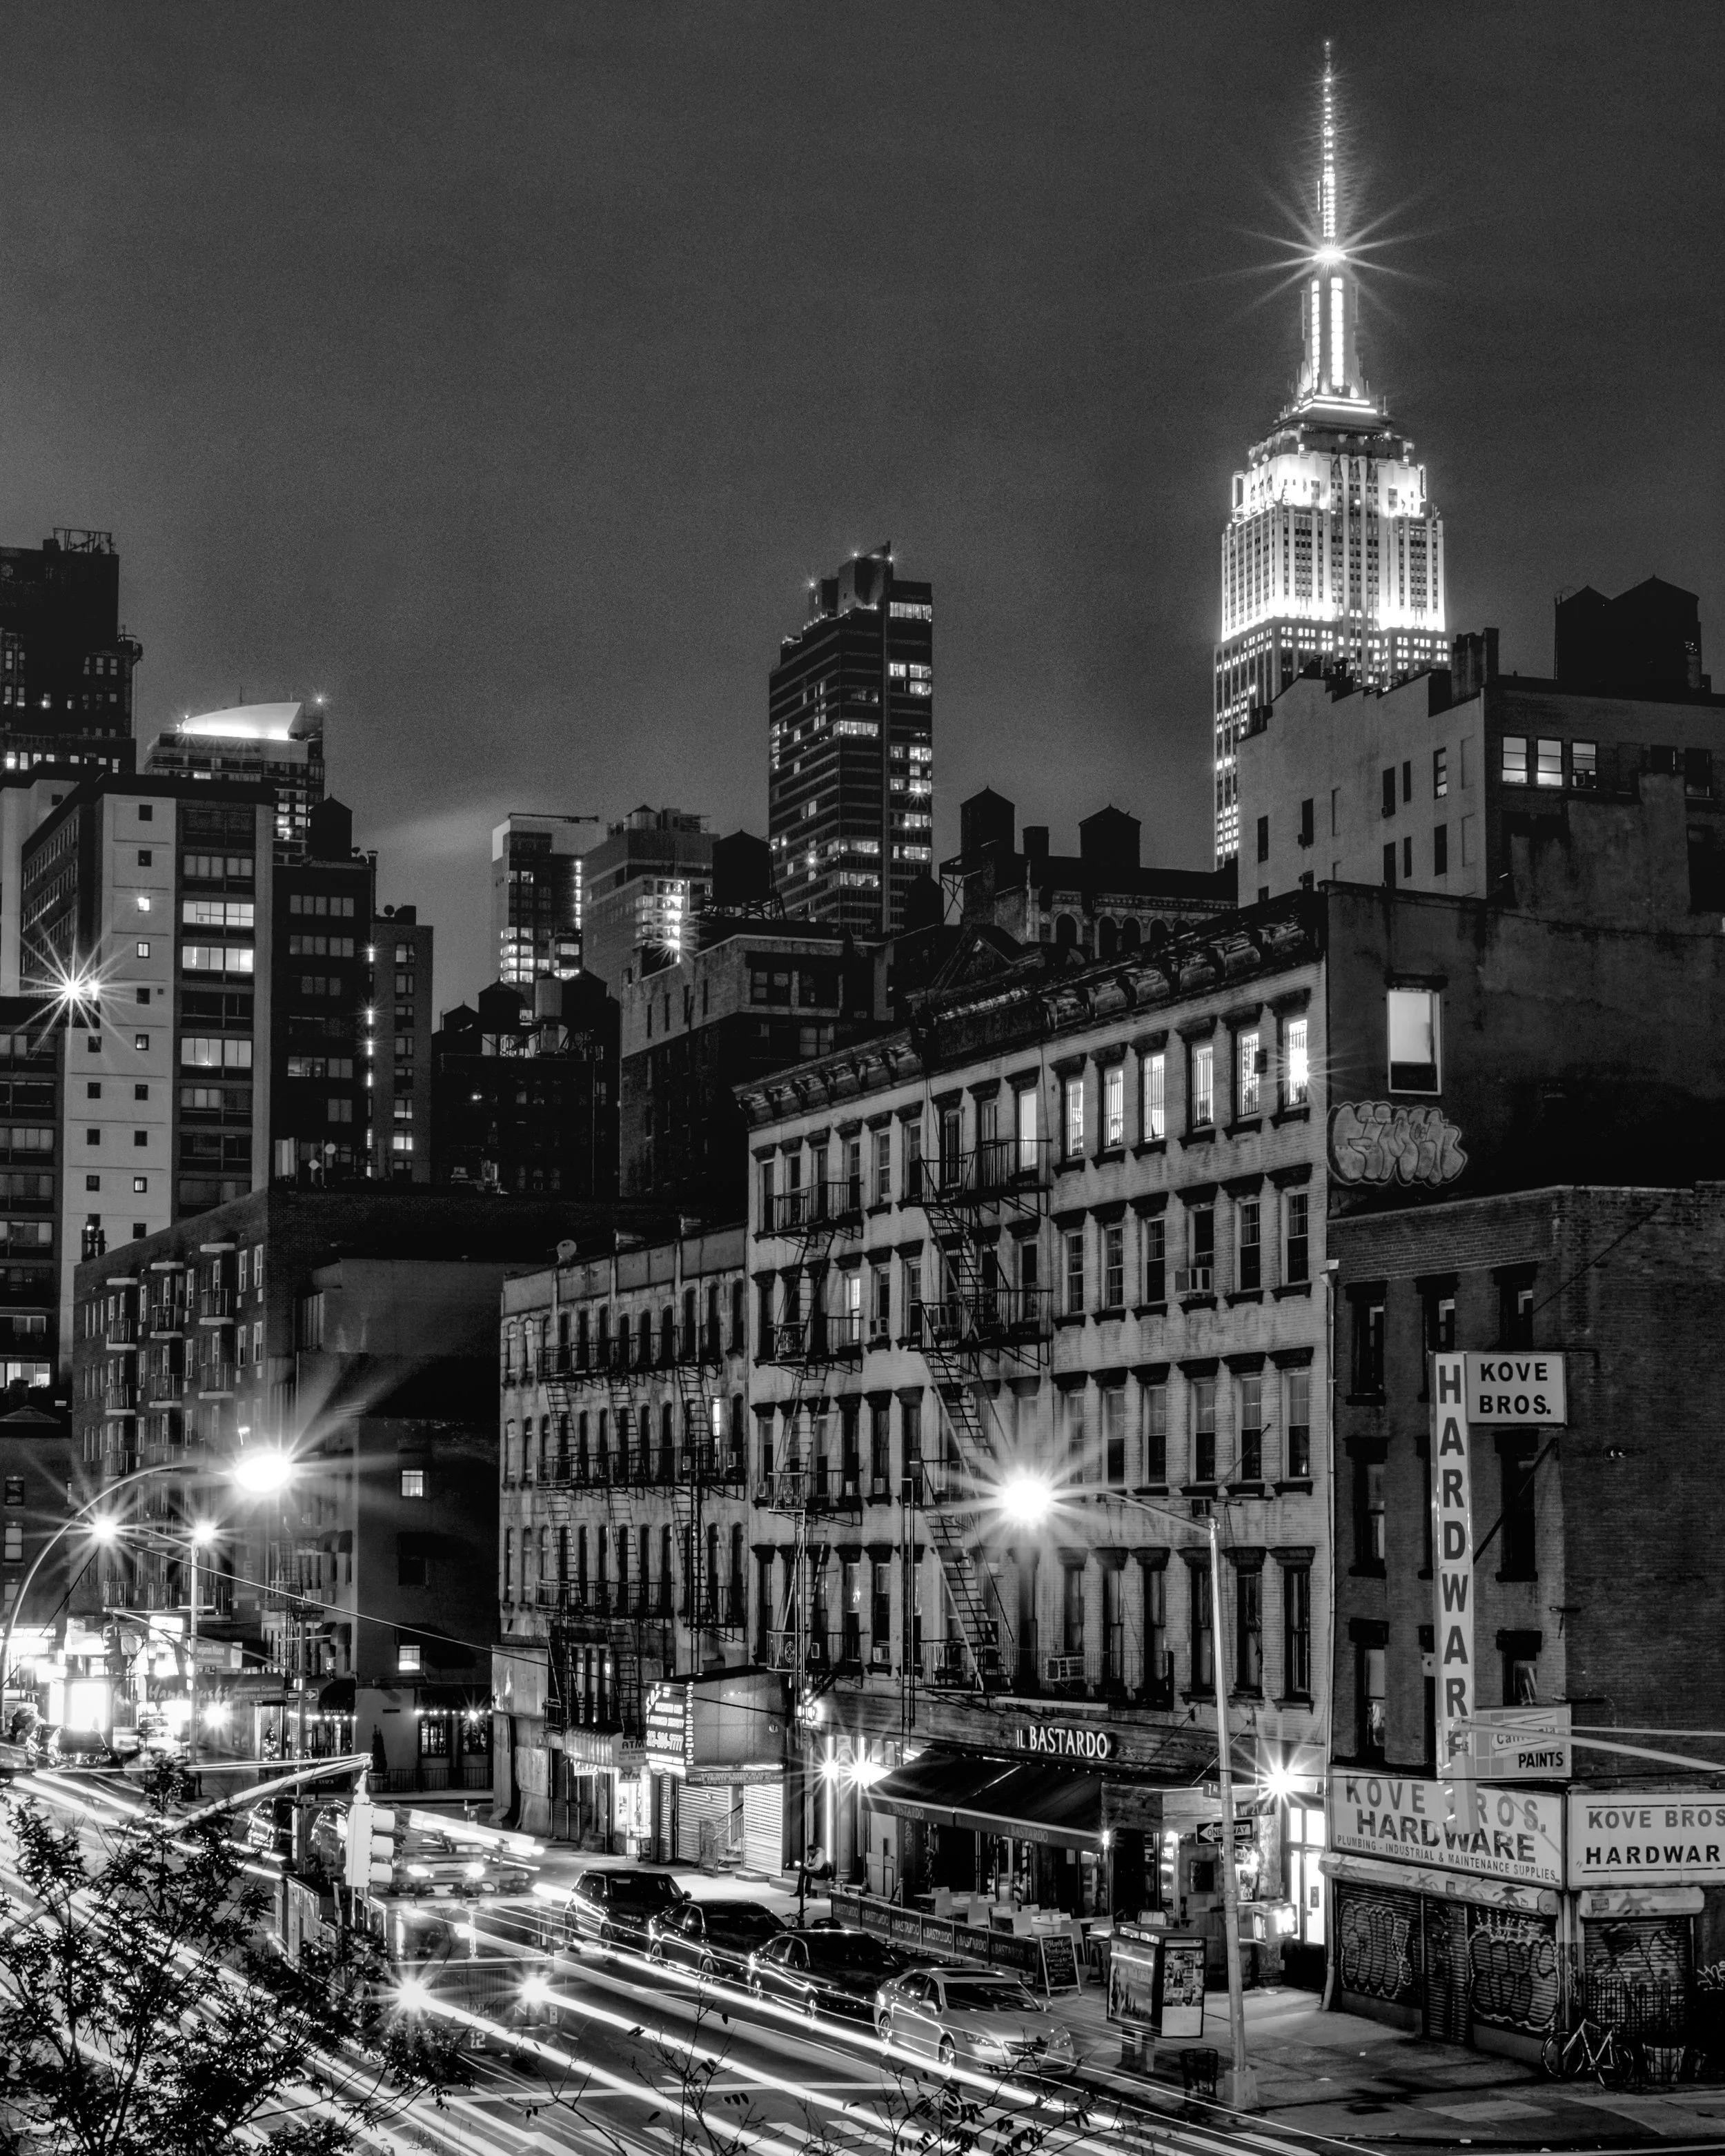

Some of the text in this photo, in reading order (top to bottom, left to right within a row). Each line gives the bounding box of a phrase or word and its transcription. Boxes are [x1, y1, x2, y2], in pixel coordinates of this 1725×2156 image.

[1480, 1362, 1548, 1381] KOVE
[1479, 1394, 1551, 1414] BROS.
[148, 1684, 229, 1701] Hana ushi
[622, 1739, 644, 1749] ATM
[1016, 1725, 1107, 1759] IL BASTARDO
[1519, 1752, 1564, 1768] PAINTS
[892, 1804, 925, 1820] BASTARDO
[1239, 1805, 1248, 1816] W
[1346, 1776, 1546, 1833] KOVE ROS.
[1588, 1809, 1725, 1829] KOVE BROS
[1010, 1827, 1049, 1843] BASTARDO
[1208, 1828, 1222, 1837] ONE
[1357, 1809, 1536, 1863] HARDWARE
[1337, 1834, 1377, 1851] PLUMBING
[1386, 1843, 1435, 1861] INDUSTRIAL
[1439, 1852, 1443, 1863] &
[1448, 1853, 1510, 1874] MAINTENANCE
[895, 1919, 920, 1936] BASTARDO
[926, 1927, 952, 1944] BASTARDO
[959, 1935, 987, 1952] BASTARDO
[470, 2031, 486, 2049] 12
